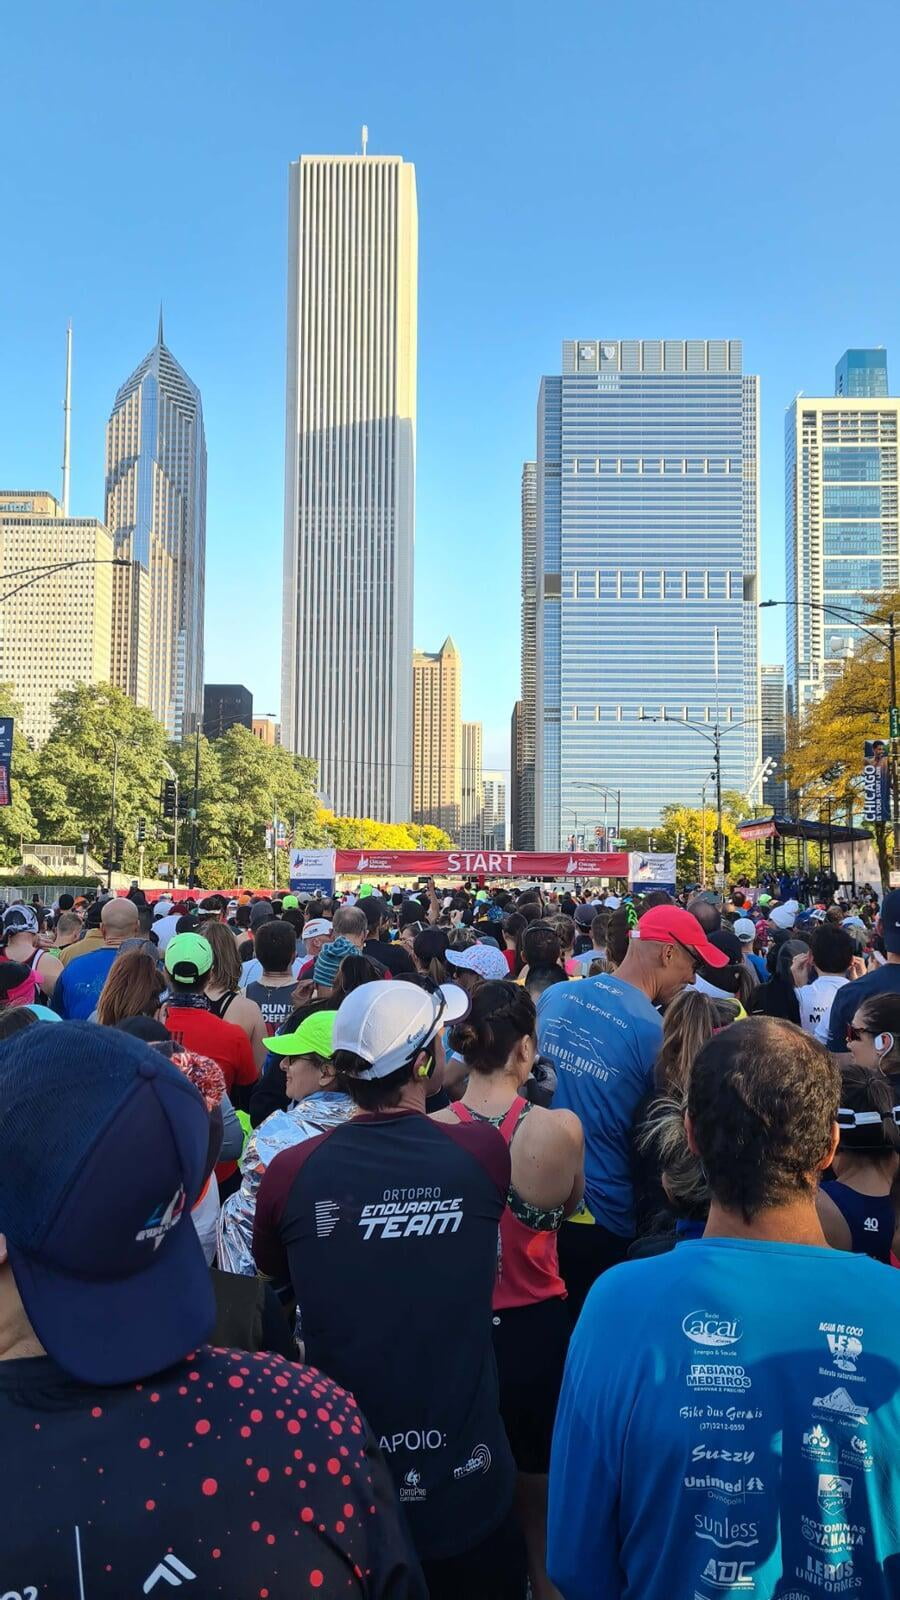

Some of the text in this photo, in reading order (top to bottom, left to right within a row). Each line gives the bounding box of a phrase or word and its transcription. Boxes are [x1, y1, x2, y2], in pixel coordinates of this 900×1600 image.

[865, 765, 876, 822] CHICAGO
[447, 853, 517, 873] START
[261, 1003, 286, 1013] RUN
[586, 1003, 610, 1019] DEFINE
[612, 1017, 628, 1029] YOU
[383, 1187, 441, 1201] ORTOPRO
[361, 1198, 463, 1218] ENDURANCE
[358, 1211, 464, 1240] TEAM
[864, 1217, 879, 1229] 40
[837, 1324, 845, 1333] DE
[846, 1326, 864, 1337] COCO
[691, 1365, 745, 1377] FABIANO
[687, 1375, 751, 1388] MEDEIROS
[680, 1406, 704, 1419] Bike
[379, 1430, 447, 1453] APOIO:
[691, 1444, 755, 1465] Suzzy
[684, 1475, 742, 1492] Unimed
[801, 1515, 866, 1534] MOTOMINAS
[814, 1531, 864, 1546] YAMAHA
[703, 1558, 756, 1582] ADC
[807, 1555, 854, 1581] LEROS
[795, 1566, 863, 1593] UNIFORMES
